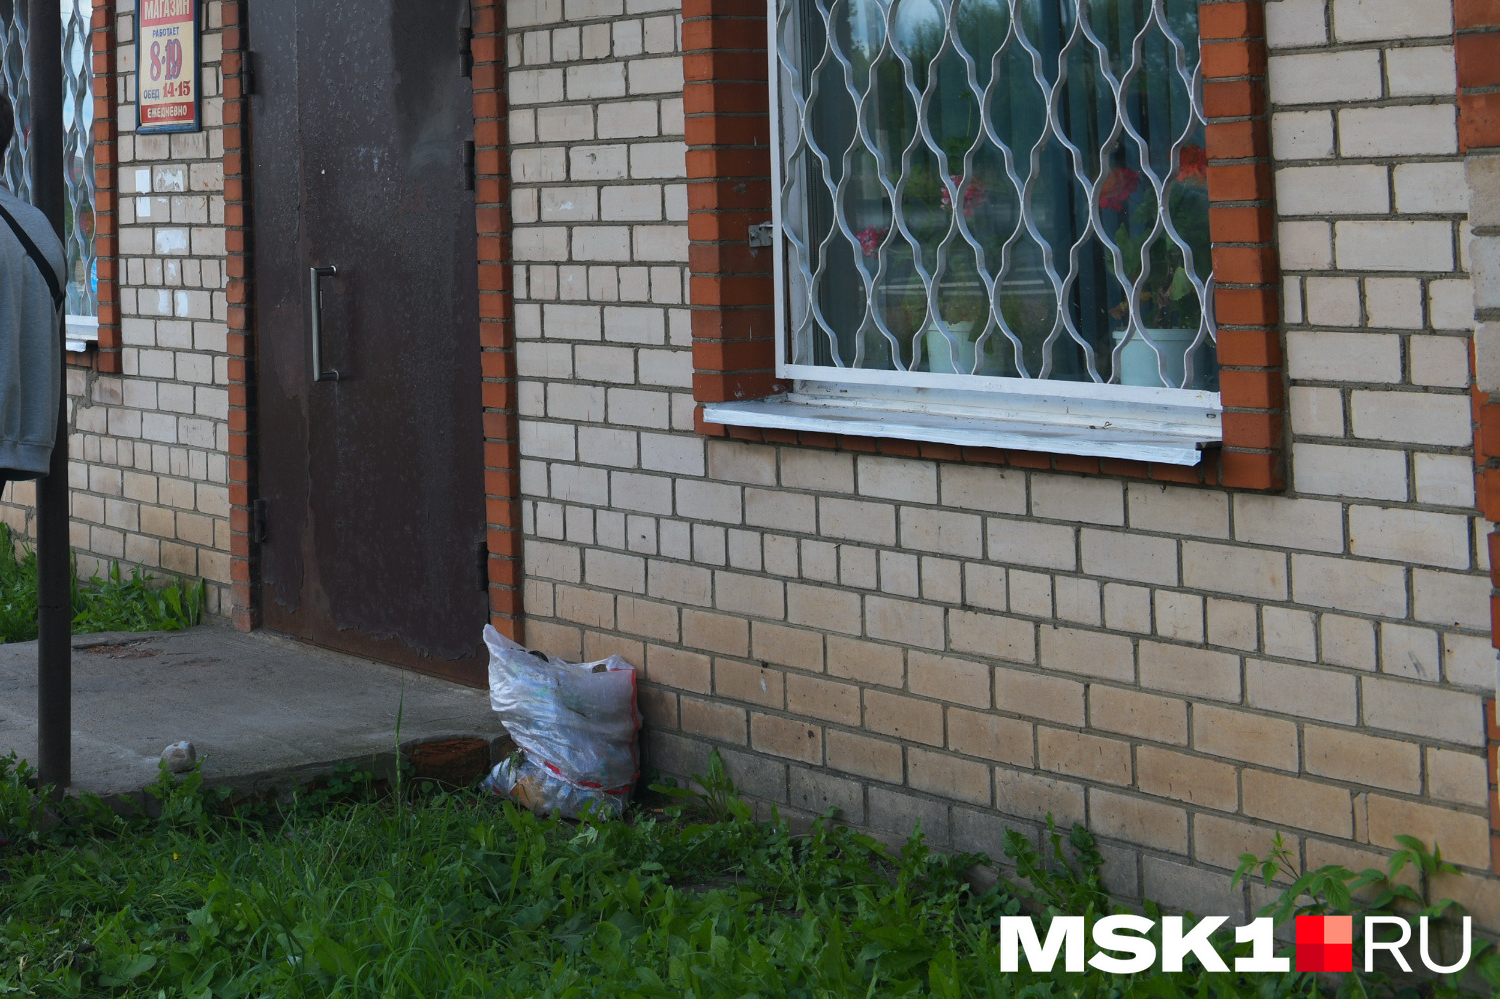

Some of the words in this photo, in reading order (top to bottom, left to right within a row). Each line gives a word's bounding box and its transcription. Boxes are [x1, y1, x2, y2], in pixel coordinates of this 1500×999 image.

[152, 26, 180, 37] РАБОТАЕТ
[143, 88, 160, 100] ОБЕД
[147, 104, 188, 119] ЕЖЕДНЕВНО
